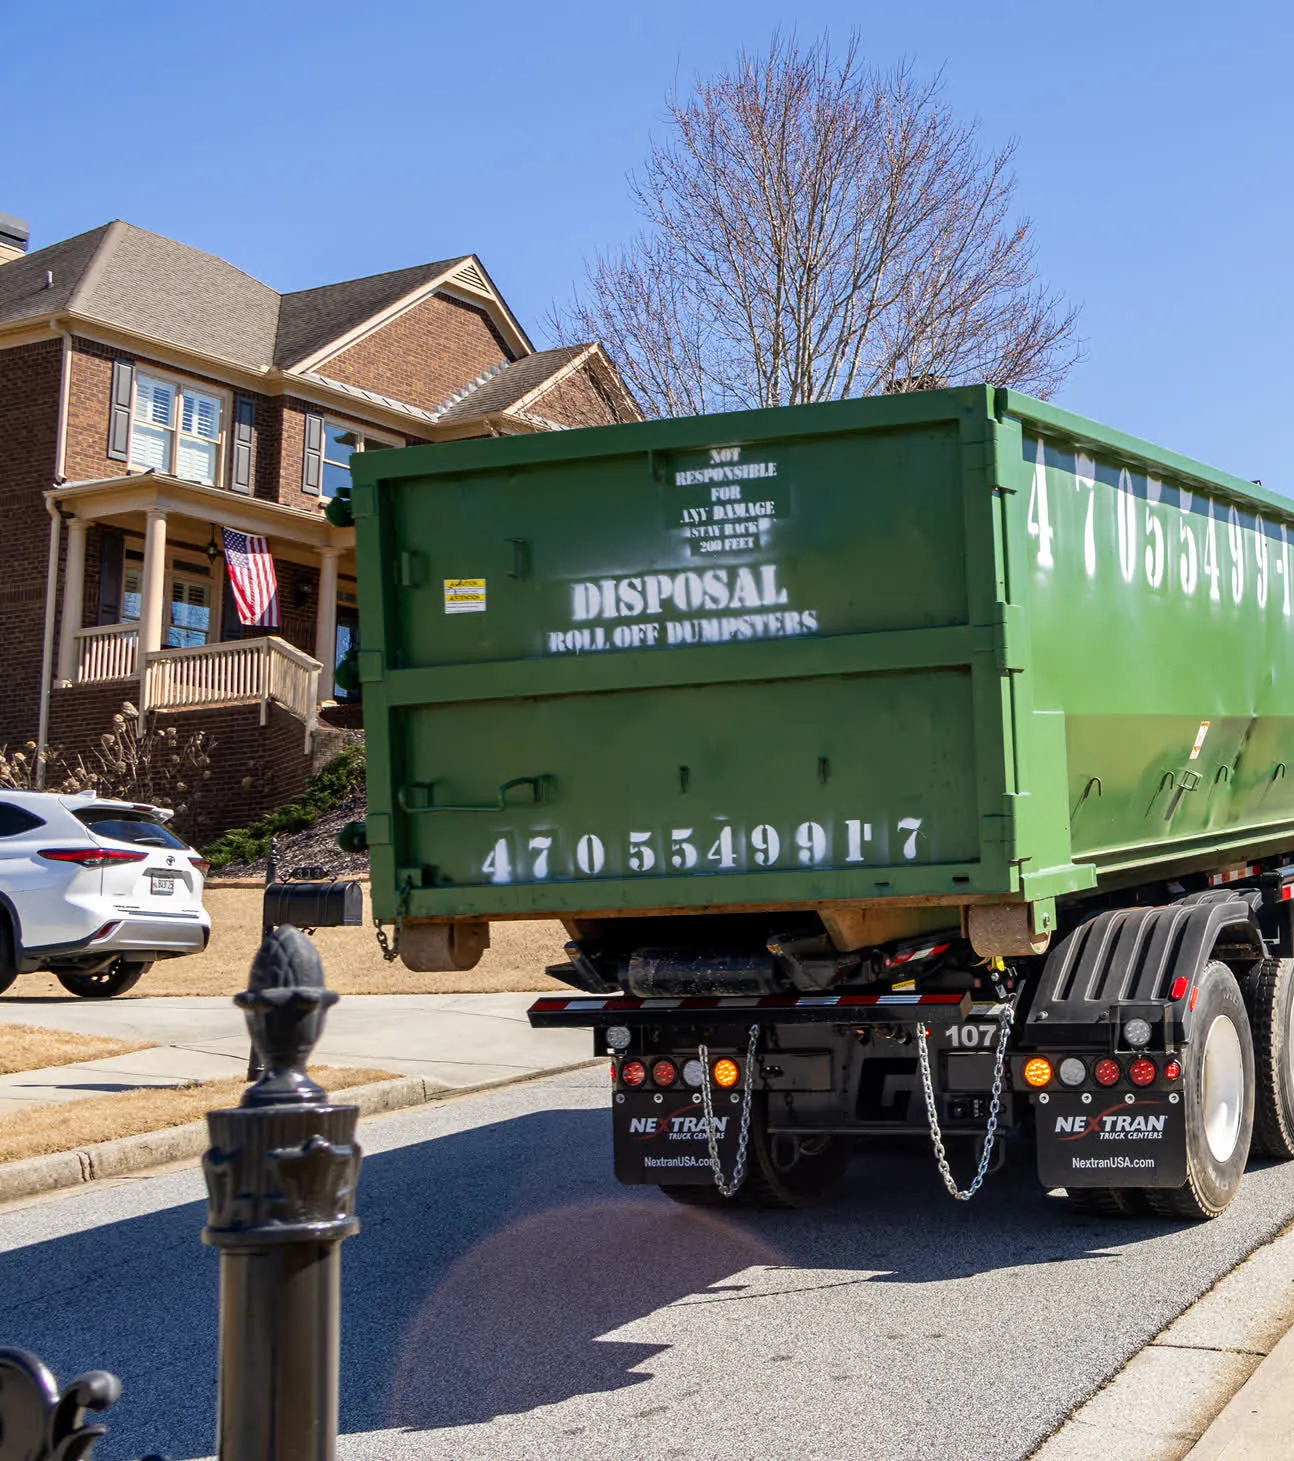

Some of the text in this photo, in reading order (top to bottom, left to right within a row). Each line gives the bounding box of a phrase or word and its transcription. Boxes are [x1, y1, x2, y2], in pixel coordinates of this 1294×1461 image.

[710, 447, 742, 464] NOT
[675, 463, 778, 486] RESPONSIBLE
[711, 485, 742, 501] FOR
[680, 501, 776, 523] ANY DAMAGE
[690, 521, 758, 538] STAY BACK
[700, 537, 754, 552] 200 FEET
[570, 564, 788, 621] DISPOSAL
[547, 610, 819, 653] ROLL OFF DUMPSTERS
[945, 1025, 997, 1047] 107
[629, 1117, 729, 1133] NEXTRAN
[1055, 1115, 1166, 1133] NEXTRAN
[668, 1132, 725, 1140] TRUCK CENRS
[1100, 1131, 1163, 1140] TRUCK CENTERS
[1072, 1156, 1155, 1169] NextranUSA.com
